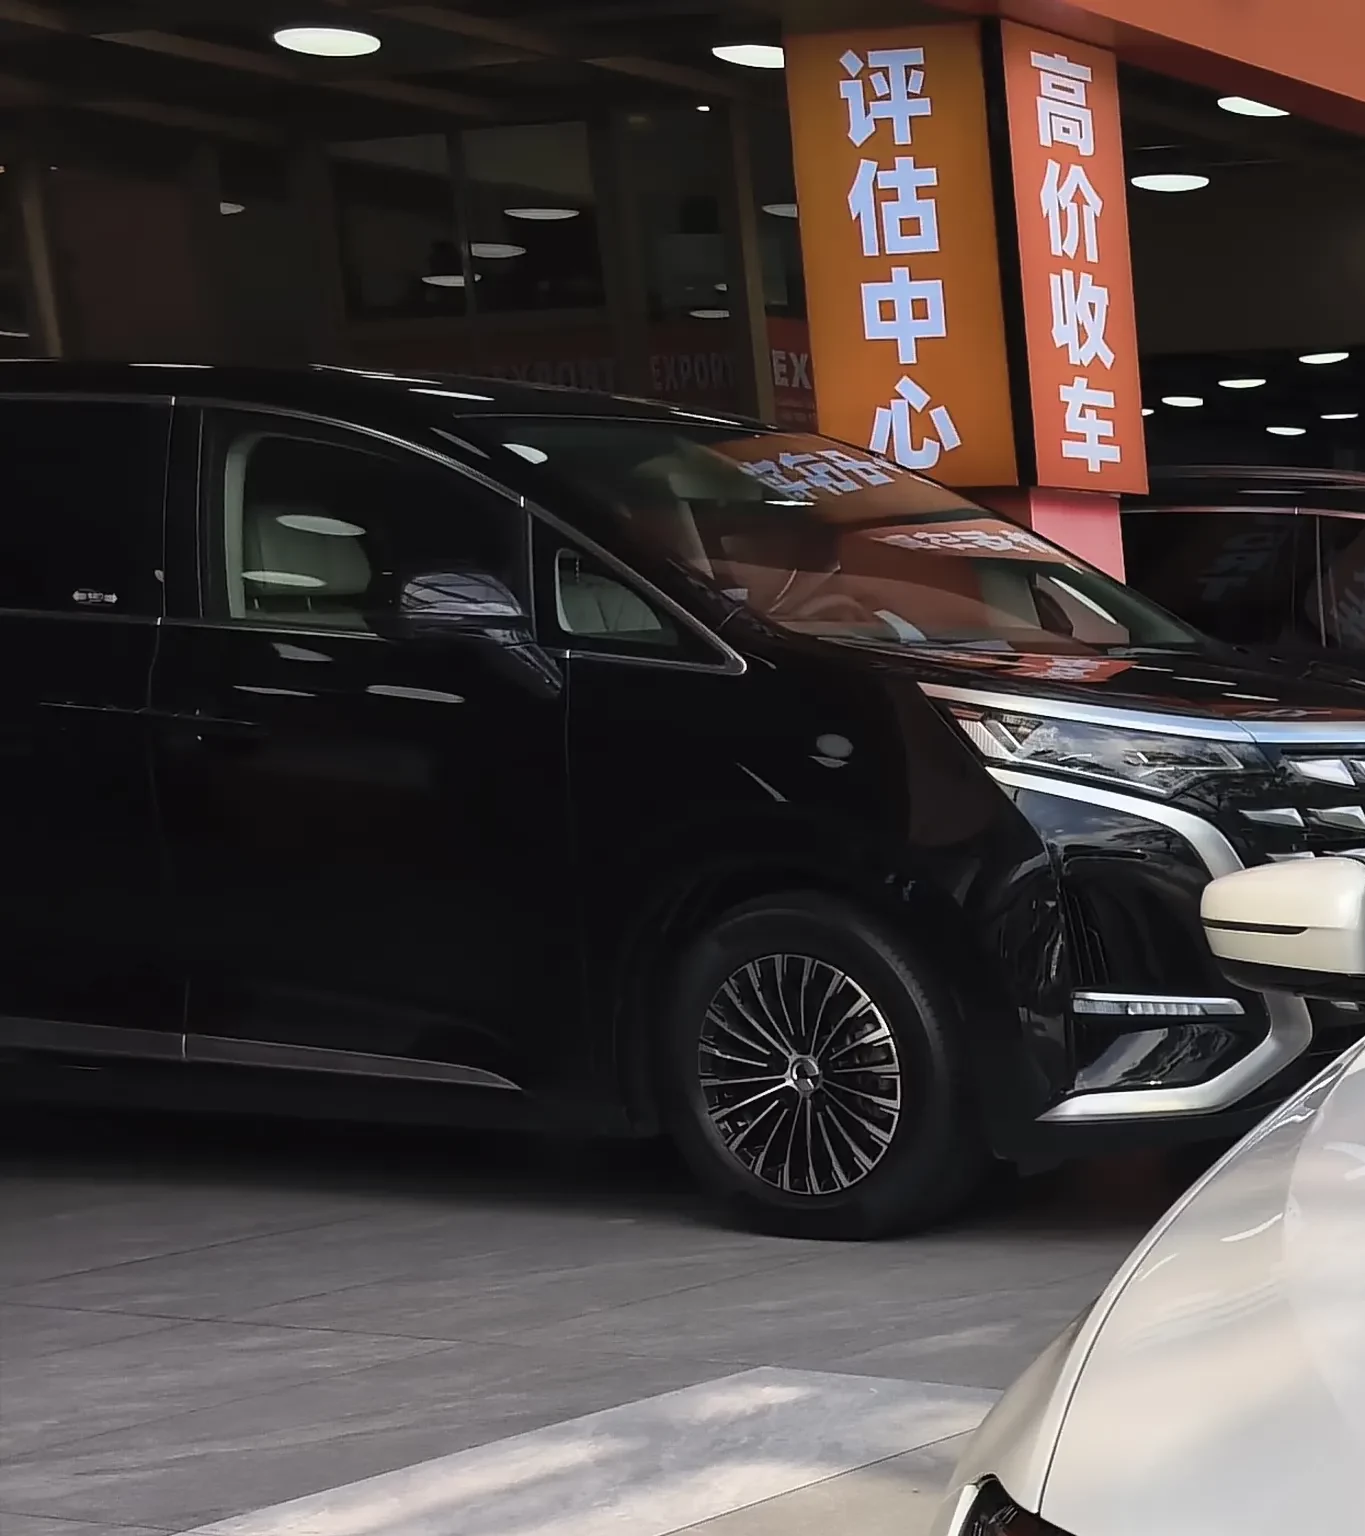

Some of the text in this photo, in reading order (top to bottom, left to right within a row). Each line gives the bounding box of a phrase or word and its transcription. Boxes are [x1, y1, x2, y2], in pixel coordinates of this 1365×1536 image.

[839, 47, 962, 469] 评估中心
[1030, 52, 1122, 472] 高价收车
